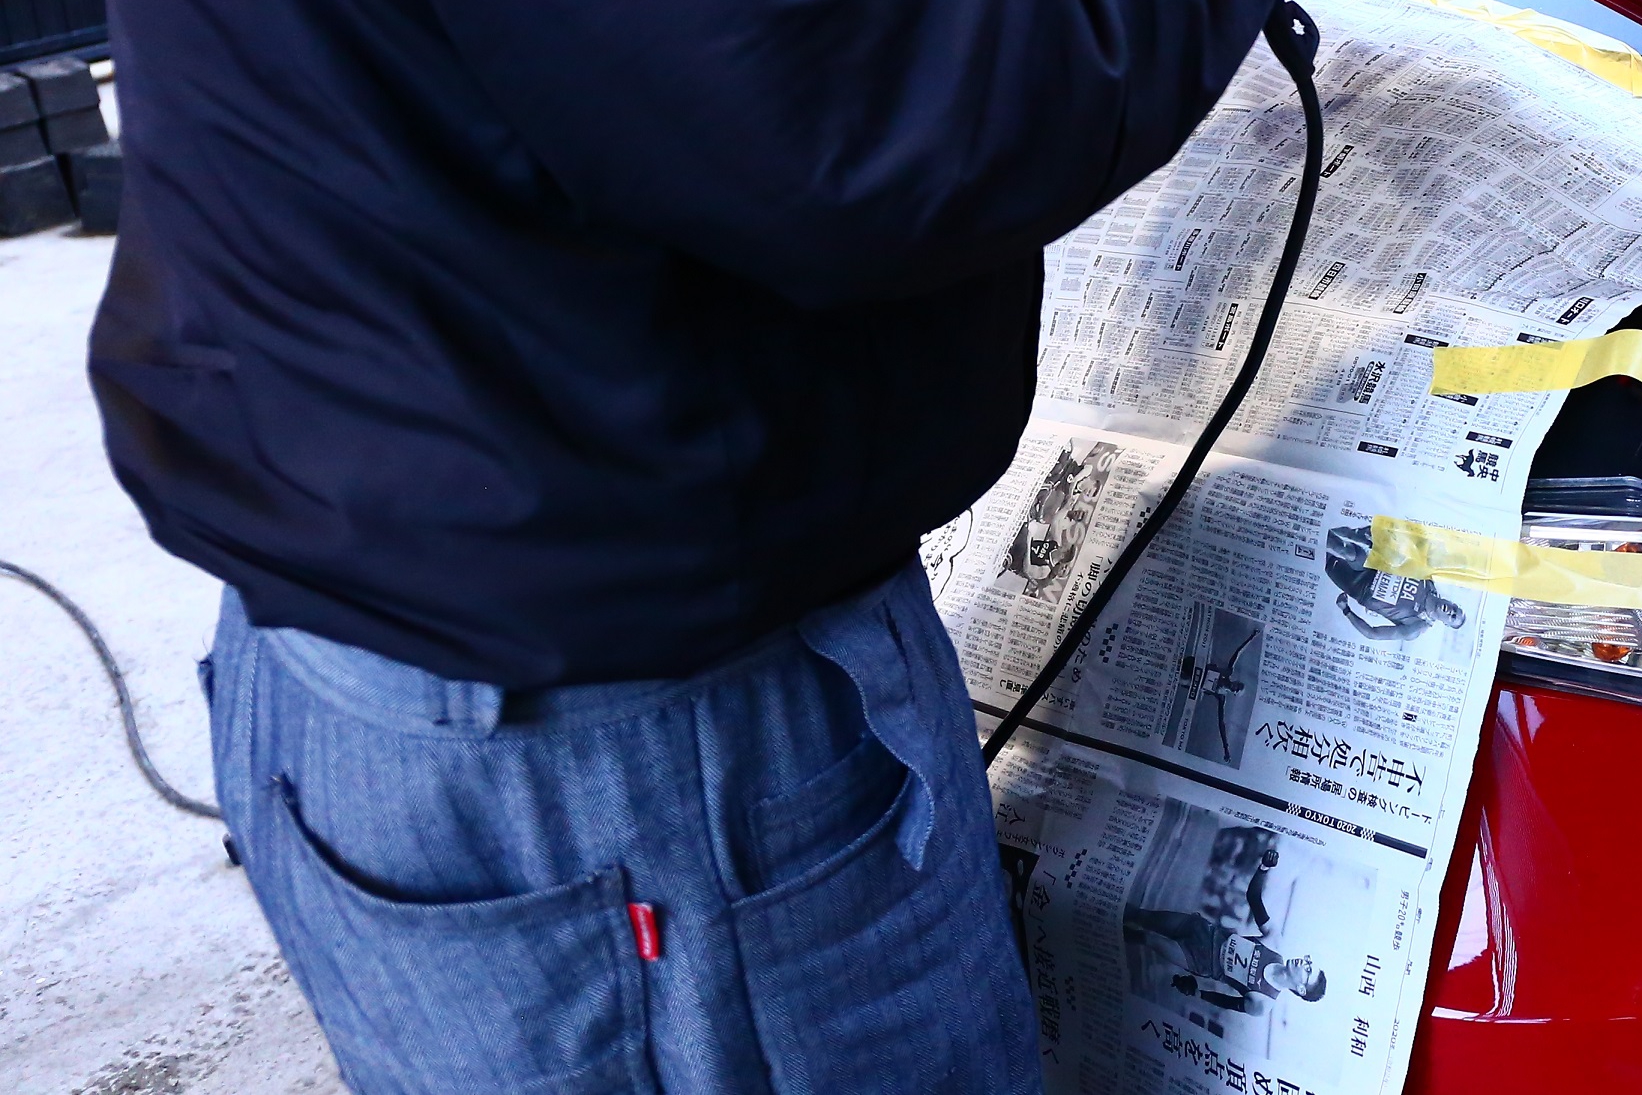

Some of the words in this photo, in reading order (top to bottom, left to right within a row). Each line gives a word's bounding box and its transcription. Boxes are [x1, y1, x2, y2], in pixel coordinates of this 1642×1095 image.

[1358, 360, 1386, 404] 水沢競馬
[1475, 449, 1500, 467] 競馬
[1478, 465, 1500, 483] 中央
[1254, 722, 1427, 796] 不申告で処分相次ぐ
[1285, 766, 1432, 825] ドーピング検査の「居場所情報」
[1304, 808, 1336, 828] TOKYO
[1335, 820, 1358, 835] 2020
[1233, 952, 1247, 968] 2
[1358, 954, 1382, 998] 山西
[1141, 1019, 1316, 1095] 固め頂点を高く
[1350, 1015, 1370, 1058] 利和
